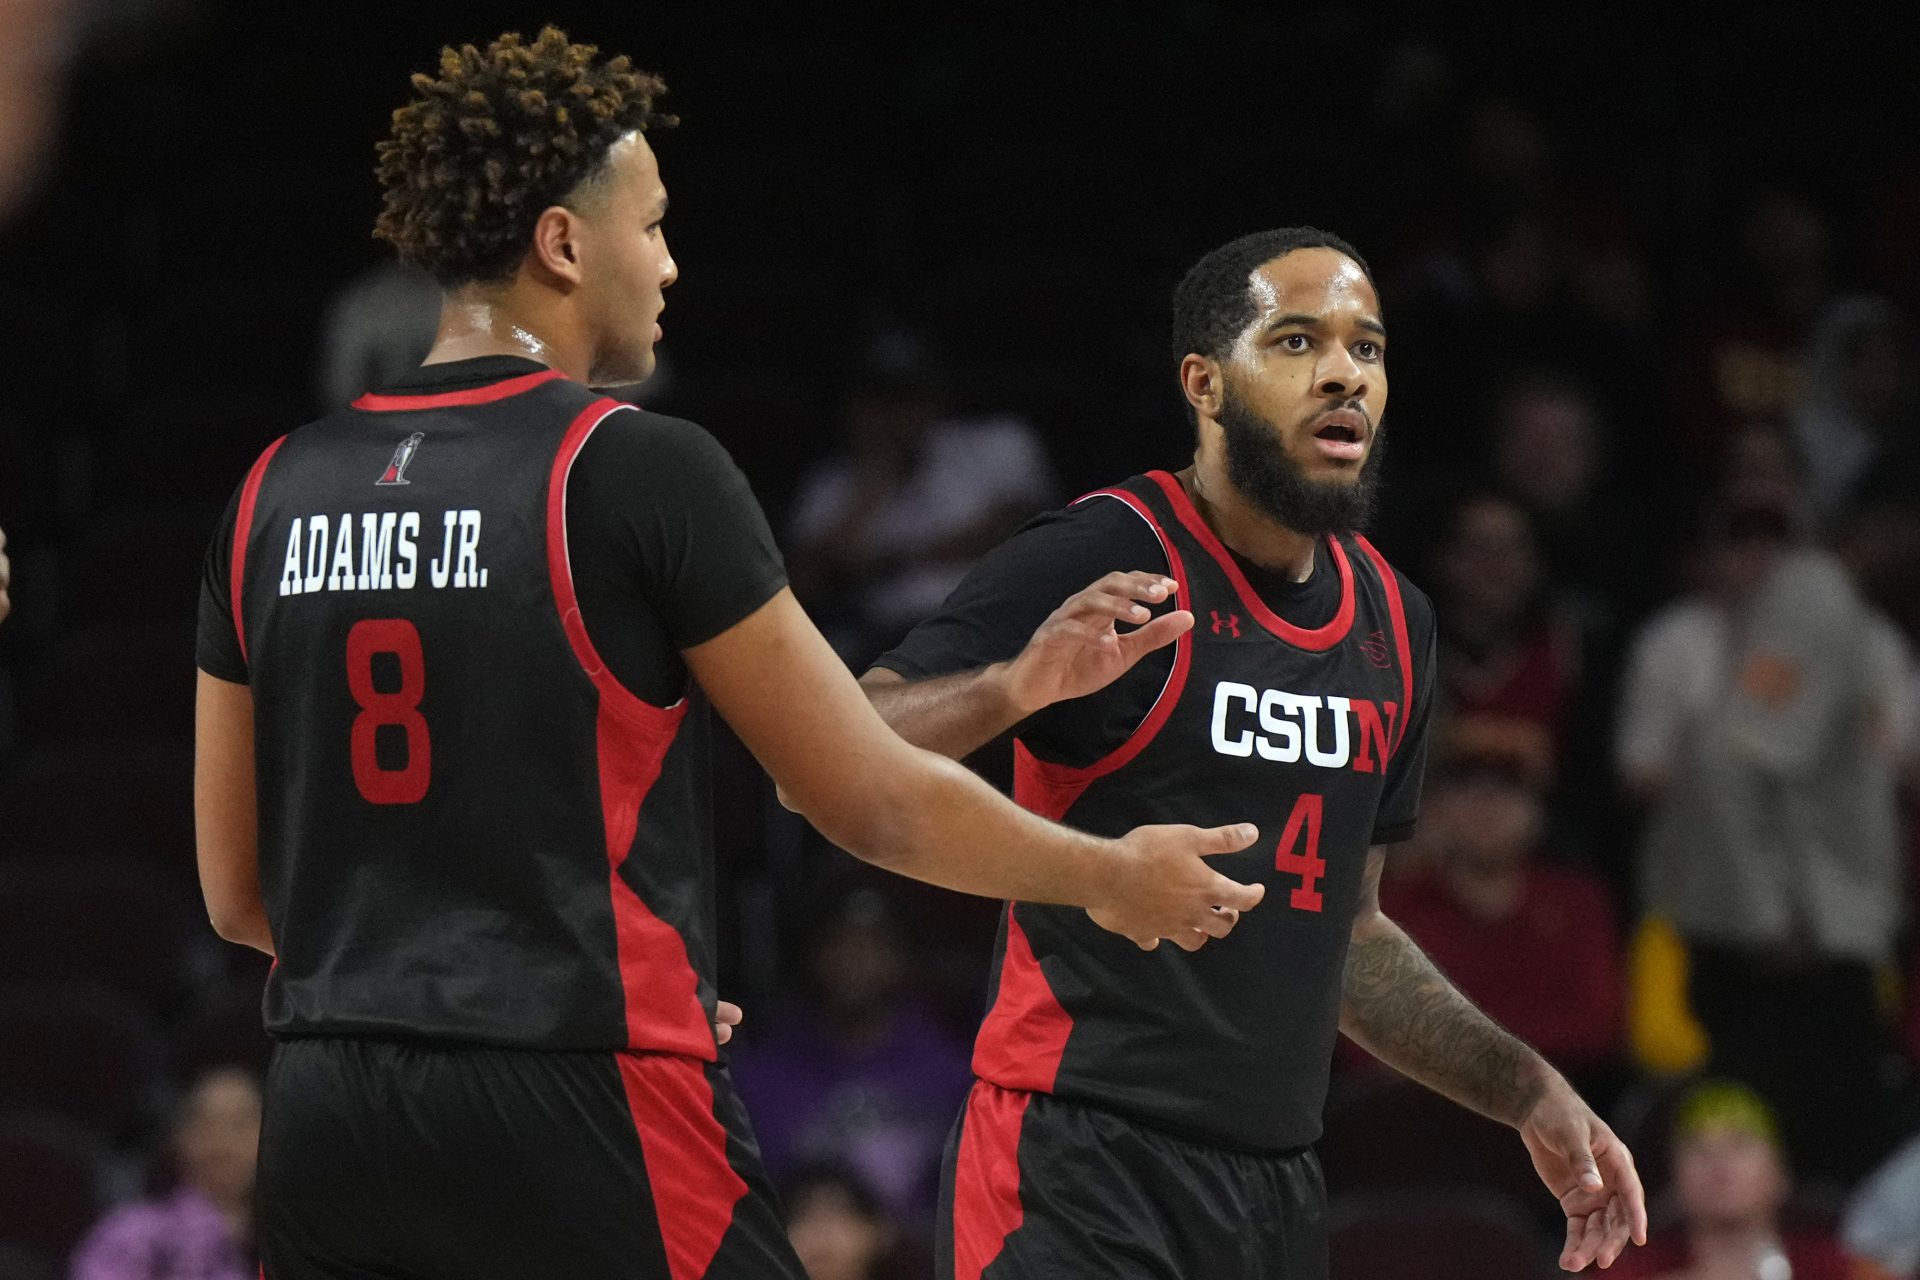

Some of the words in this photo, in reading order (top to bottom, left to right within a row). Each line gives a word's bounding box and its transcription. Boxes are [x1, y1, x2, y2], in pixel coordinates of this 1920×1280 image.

[279, 511, 420, 596] ADAMS
[430, 509, 488, 588] JR.
[346, 618, 431, 805] 8
[1210, 681, 1398, 775] CSUN
[1275, 793, 1326, 912] 4
